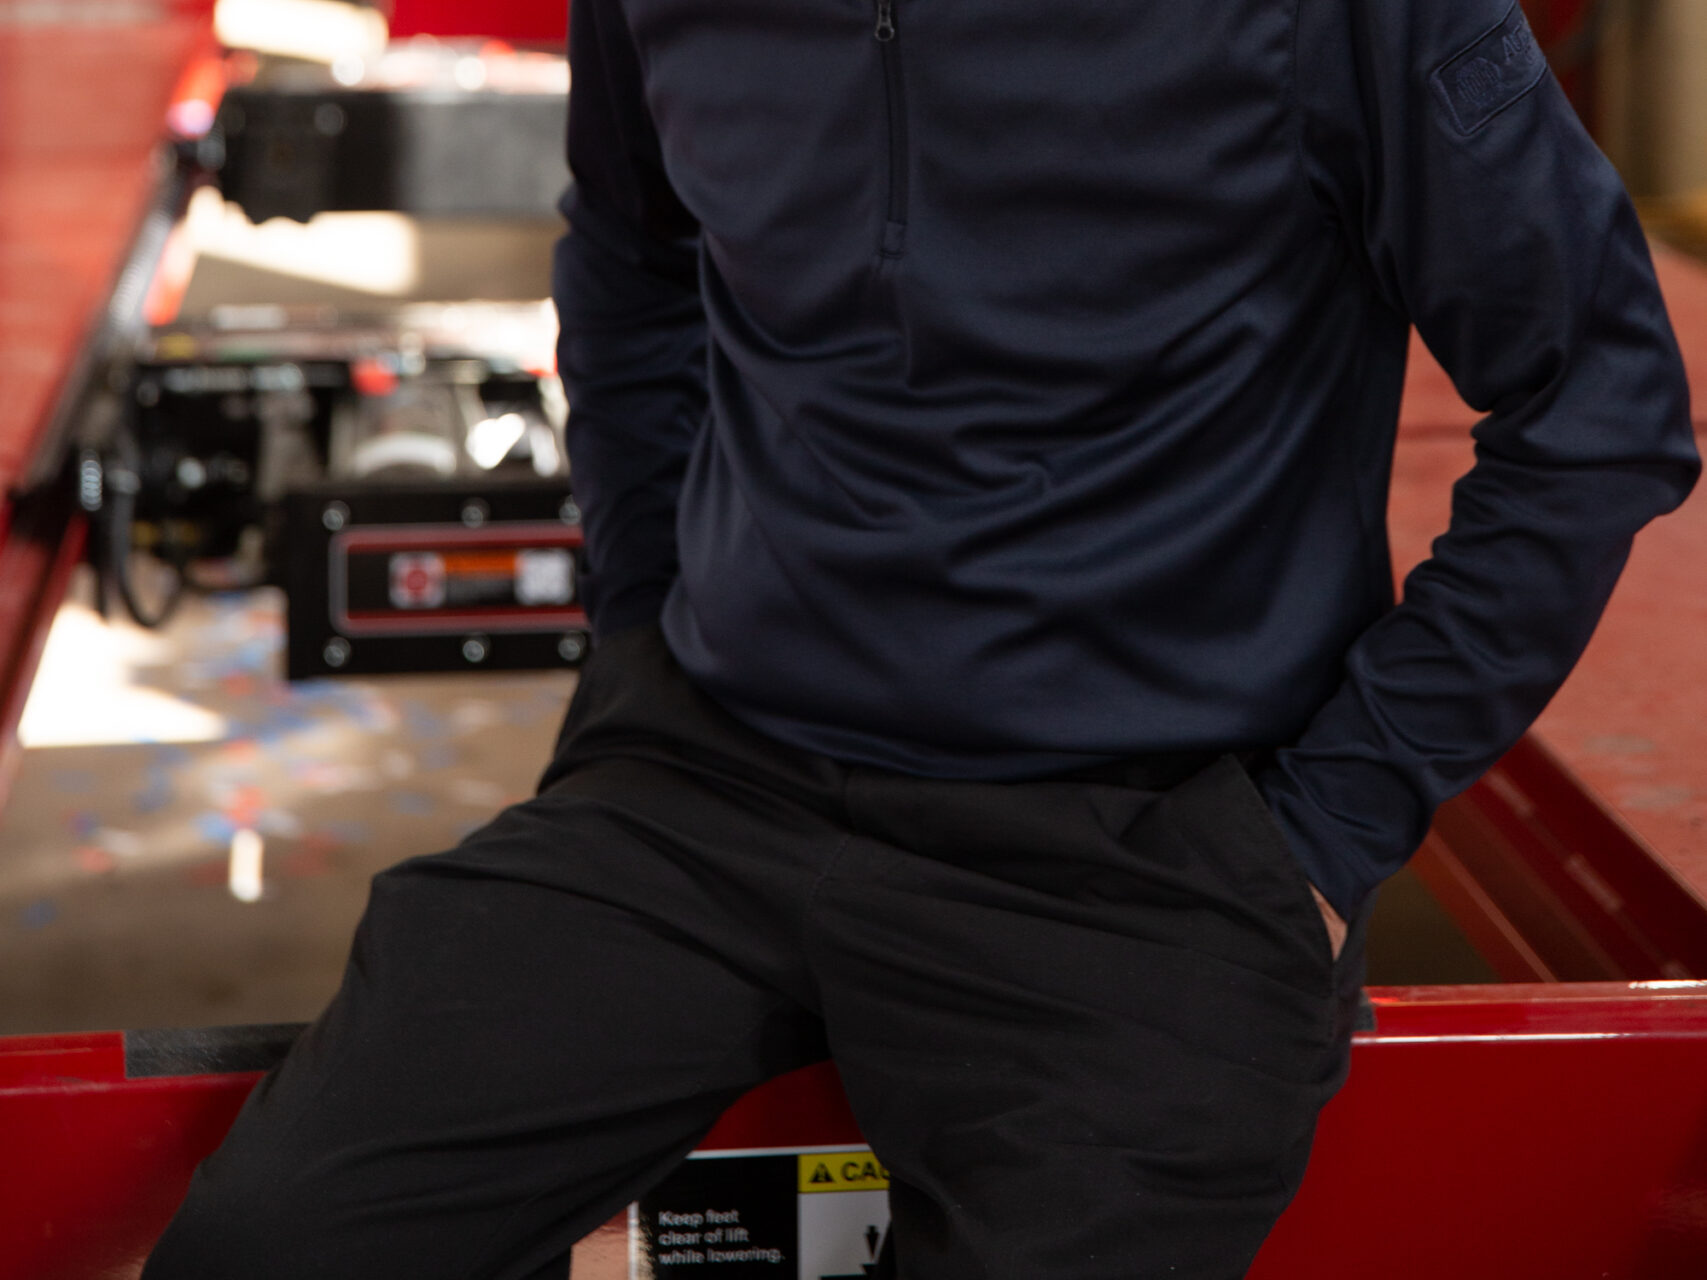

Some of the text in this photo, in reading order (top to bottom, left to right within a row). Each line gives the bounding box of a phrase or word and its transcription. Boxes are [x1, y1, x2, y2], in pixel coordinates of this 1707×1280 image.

[659, 1209, 740, 1227] Keep feet
[658, 1227, 750, 1245] clear of lift
[658, 1246, 786, 1265] while lowering.
